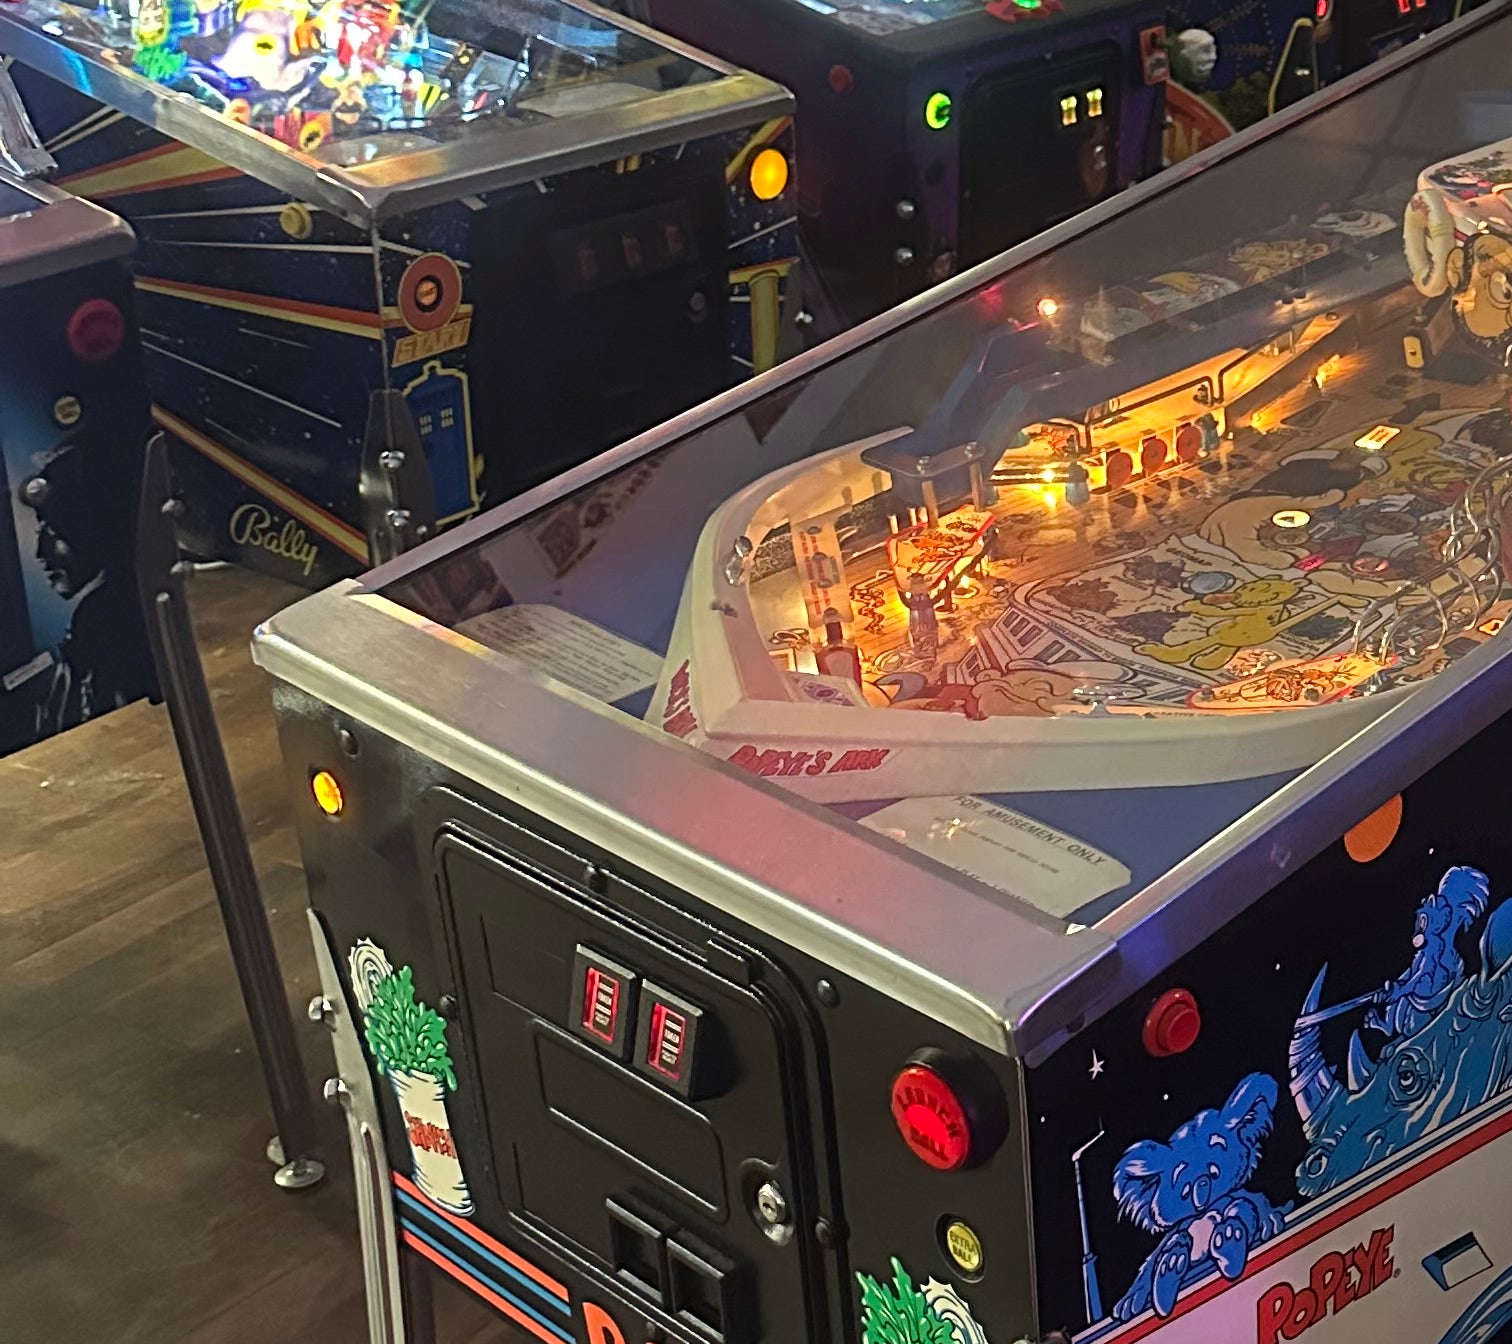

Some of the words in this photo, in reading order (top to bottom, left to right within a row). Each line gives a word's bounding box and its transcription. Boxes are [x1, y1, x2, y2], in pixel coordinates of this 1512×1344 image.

[230, 503, 318, 576] Bally
[828, 748, 891, 774] ARK
[953, 795, 983, 813] FOR
[984, 808, 1067, 847] AMUSEMENT
[1066, 842, 1107, 865] ONLY
[896, 1086, 961, 1139] LAUNCH
[909, 1124, 950, 1162] BALL
[949, 1228, 976, 1255] EXTRA
[951, 1243, 975, 1266] BALL
